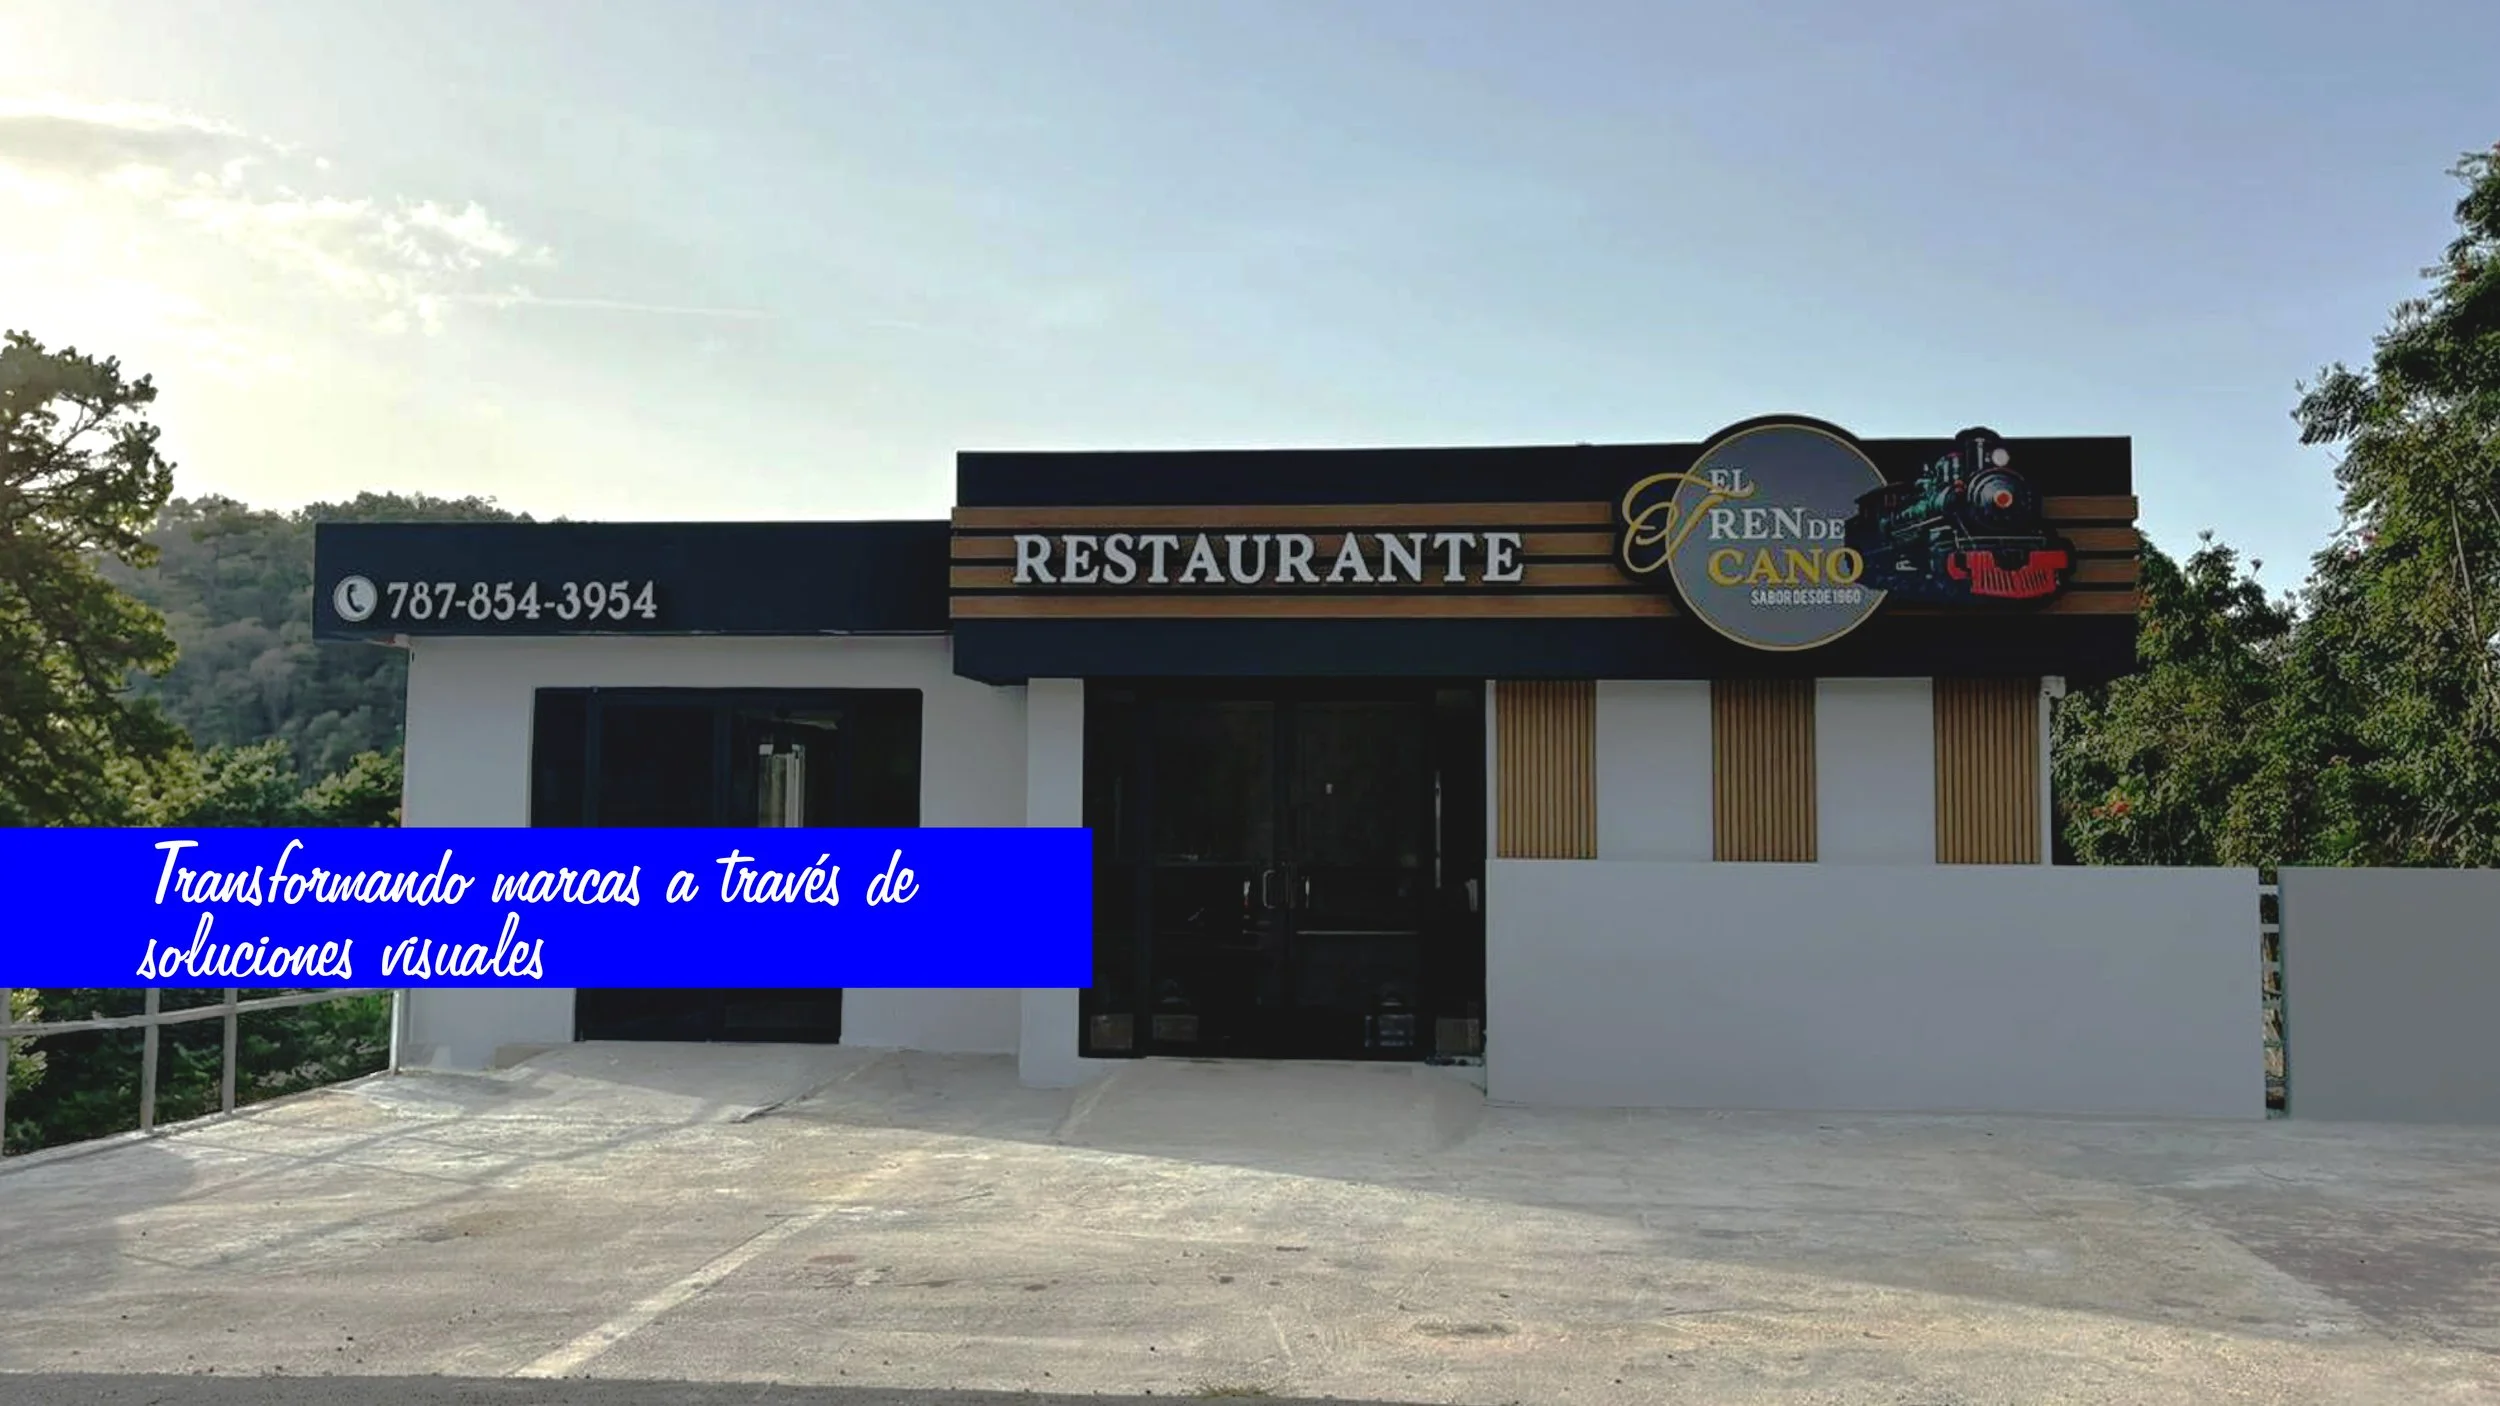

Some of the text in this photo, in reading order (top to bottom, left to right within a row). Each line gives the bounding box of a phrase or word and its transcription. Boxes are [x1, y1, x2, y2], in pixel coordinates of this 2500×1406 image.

[1709, 468, 1751, 493] EL
[1809, 518, 1846, 540] DE
[1013, 532, 1525, 584] RESTAURANTE
[1707, 548, 1864, 586] CANO
[386, 580, 657, 620] 787-854-3954
